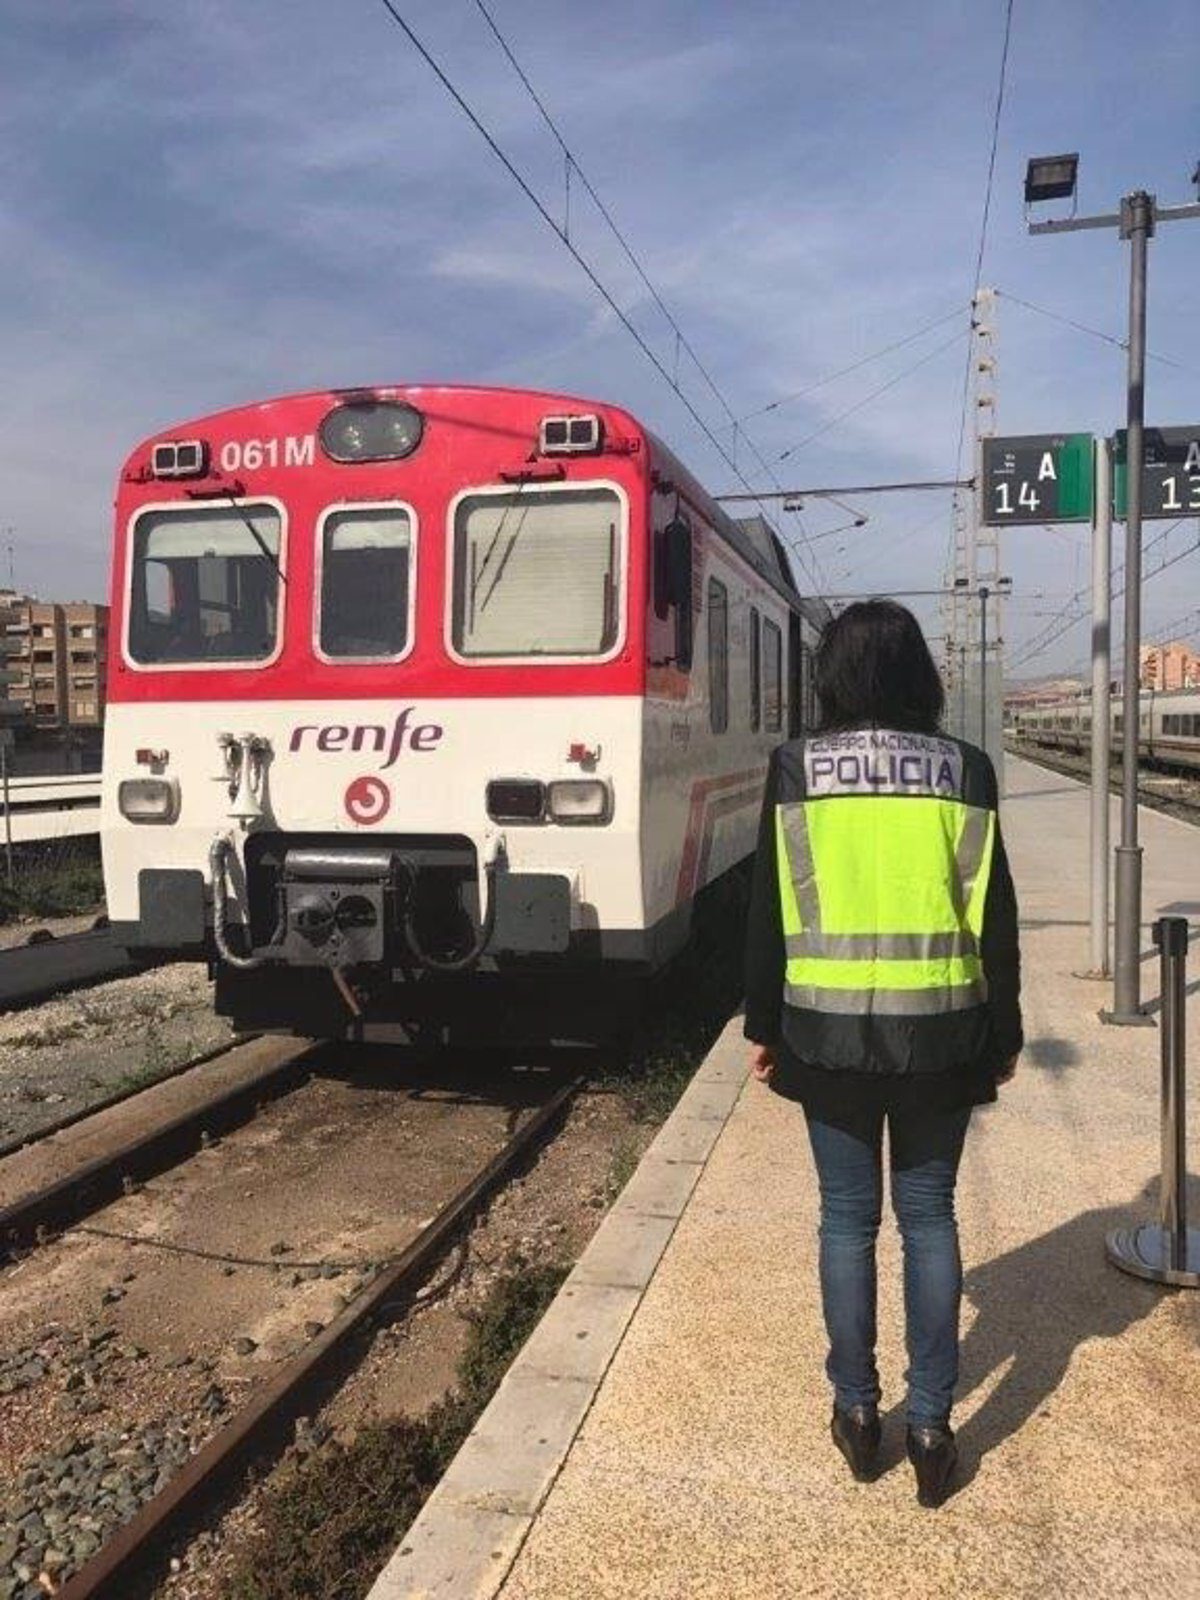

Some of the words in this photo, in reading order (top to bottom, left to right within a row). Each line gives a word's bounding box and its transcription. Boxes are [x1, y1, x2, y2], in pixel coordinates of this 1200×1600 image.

[220, 434, 315, 472] 061M
[1039, 451, 1057, 481] A
[1183, 441, 1200, 471] A
[995, 482, 1040, 513] 14
[289, 706, 443, 770] renfe
[811, 754, 955, 790] POLICIA
